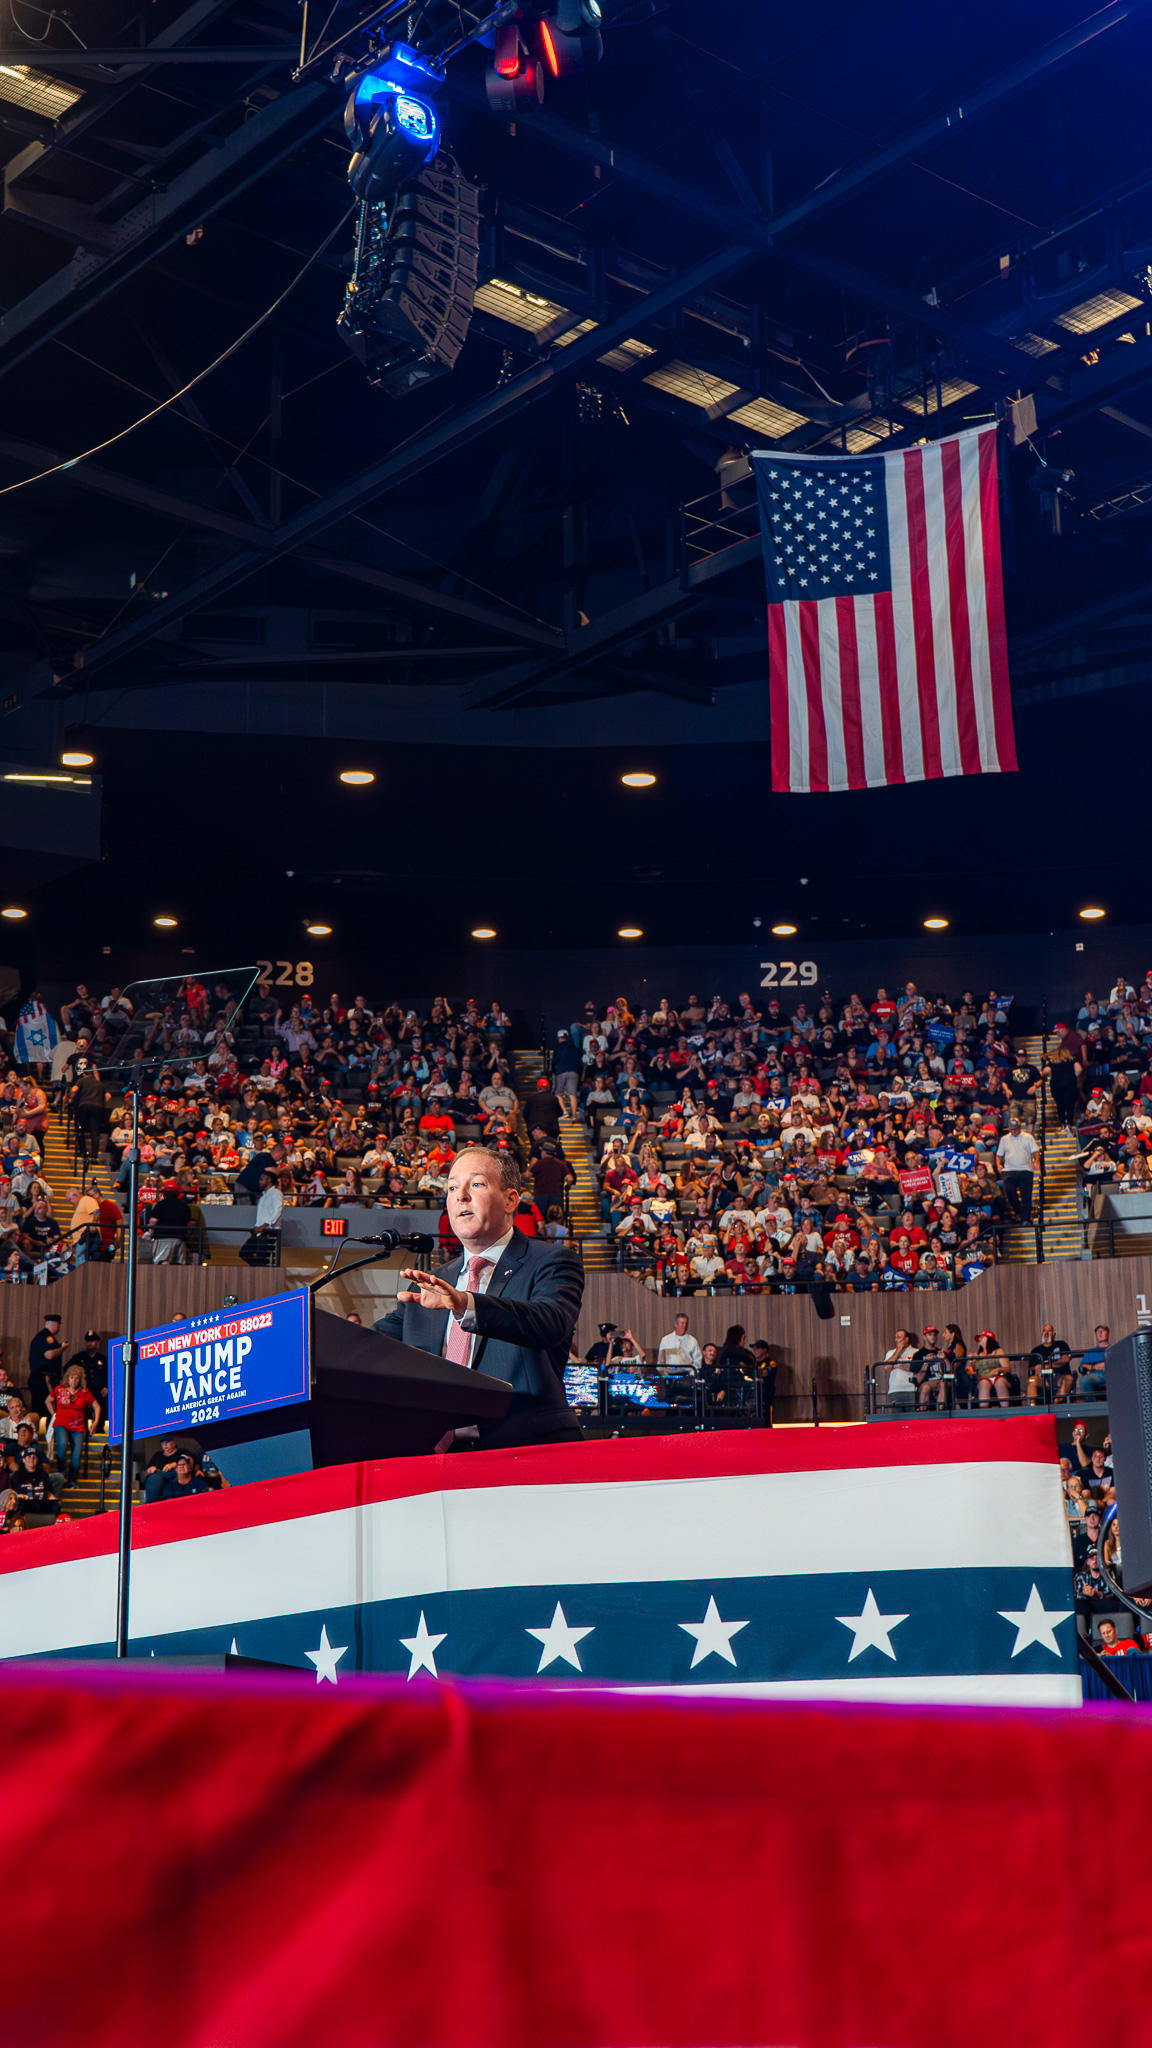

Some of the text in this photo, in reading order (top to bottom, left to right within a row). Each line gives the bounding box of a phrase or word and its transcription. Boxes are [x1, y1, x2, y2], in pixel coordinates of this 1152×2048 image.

[255, 960, 314, 987] 228
[760, 961, 818, 987] 229
[766, 1098, 786, 1110] 47
[947, 1155, 972, 1170] 47
[940, 1176, 950, 1198] RUMP
[323, 1218, 345, 1235] EXIT
[141, 1313, 272, 1358] TEXT NEW YORK TO 88022
[159, 1335, 252, 1383] TRUMP
[169, 1366, 242, 1404] VANCE
[165, 1390, 247, 1415] MAKE AMERICA GREAT AGAIN!
[191, 1406, 220, 1424] 2024
